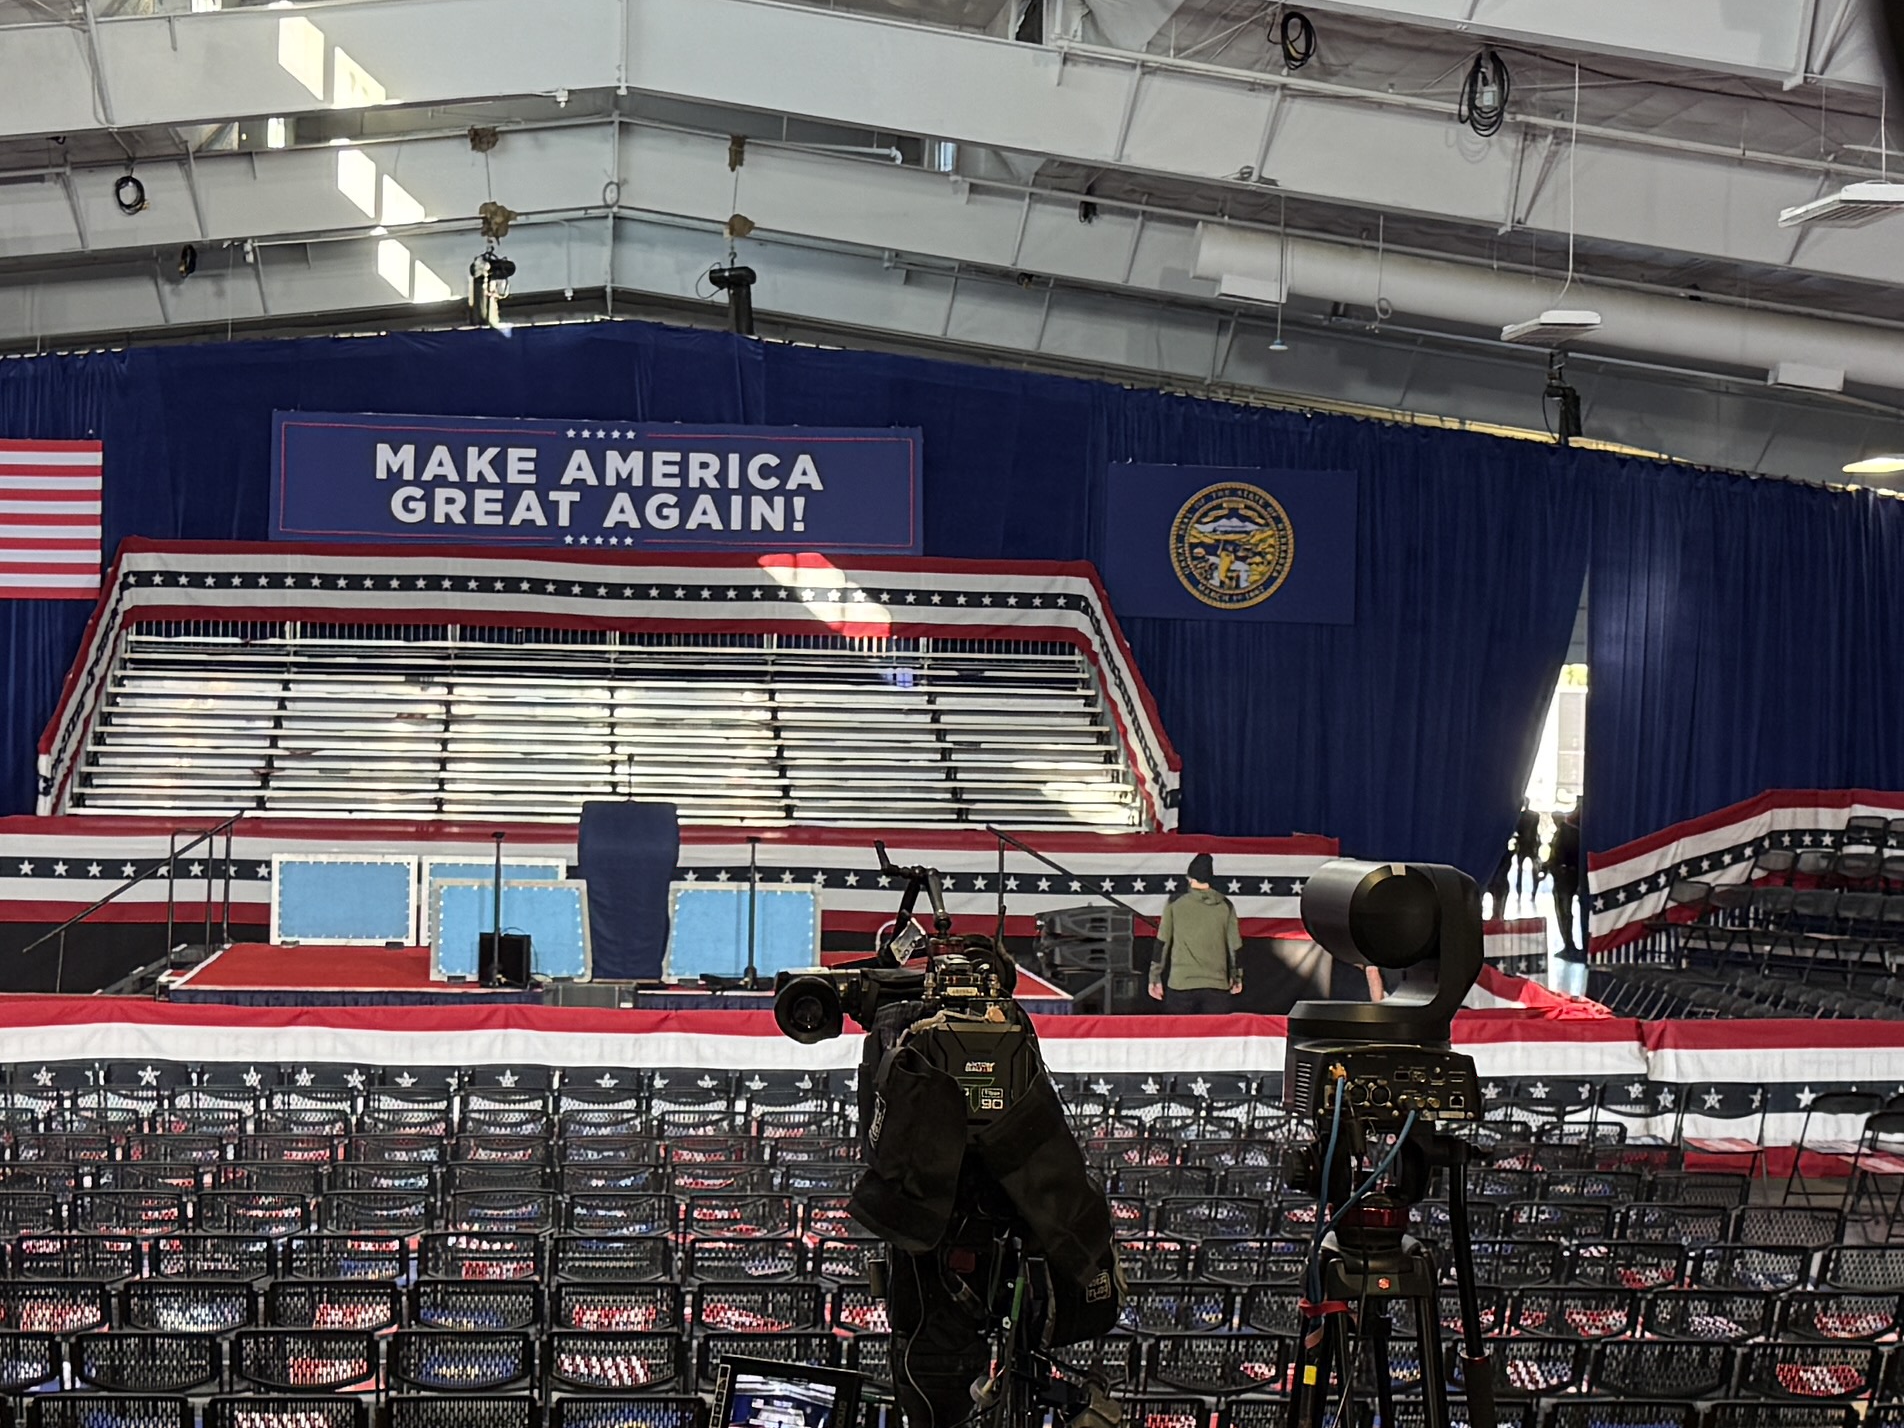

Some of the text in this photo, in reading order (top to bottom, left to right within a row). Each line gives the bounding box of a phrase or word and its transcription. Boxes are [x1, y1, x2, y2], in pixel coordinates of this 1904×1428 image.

[375, 443, 824, 491] MAKE AMERICA
[391, 486, 806, 532] GREAT AGAIN!
[981, 1099, 1003, 1110] 90
